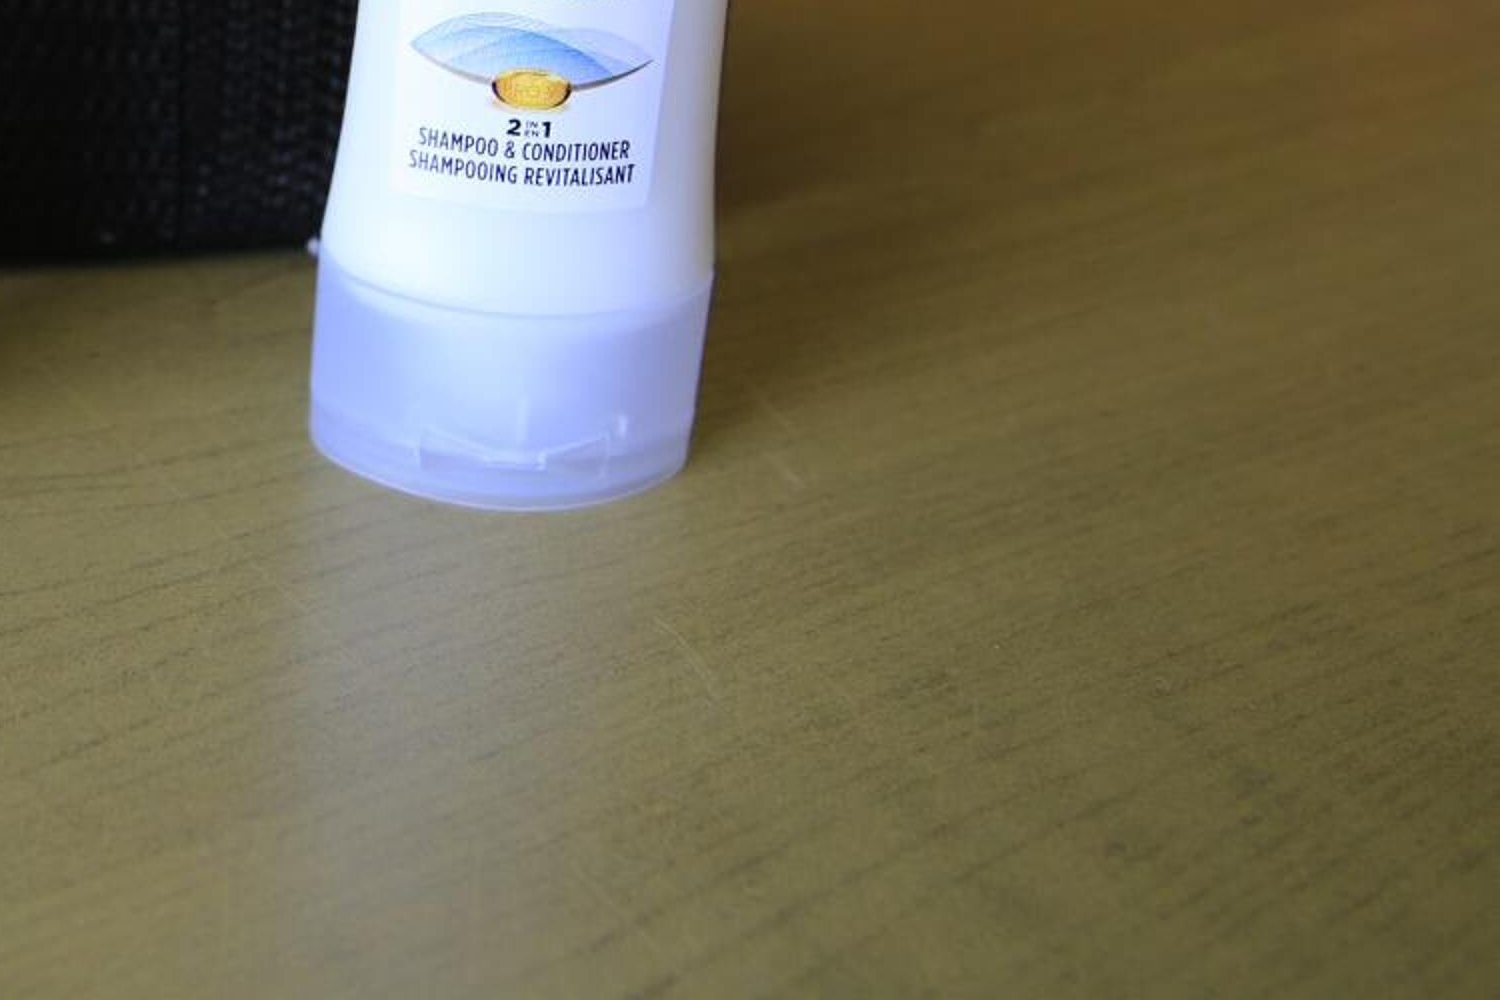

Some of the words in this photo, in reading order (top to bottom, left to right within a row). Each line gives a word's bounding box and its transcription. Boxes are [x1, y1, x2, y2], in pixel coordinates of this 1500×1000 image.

[419, 127, 498, 157] SHAMPOO
[503, 140, 515, 159] &
[522, 140, 631, 162] CONDITIONER
[506, 118, 521, 137] 2
[542, 121, 551, 138] 1
[409, 150, 517, 184] SHAMPOOING
[523, 164, 635, 187] REVITALISANT
